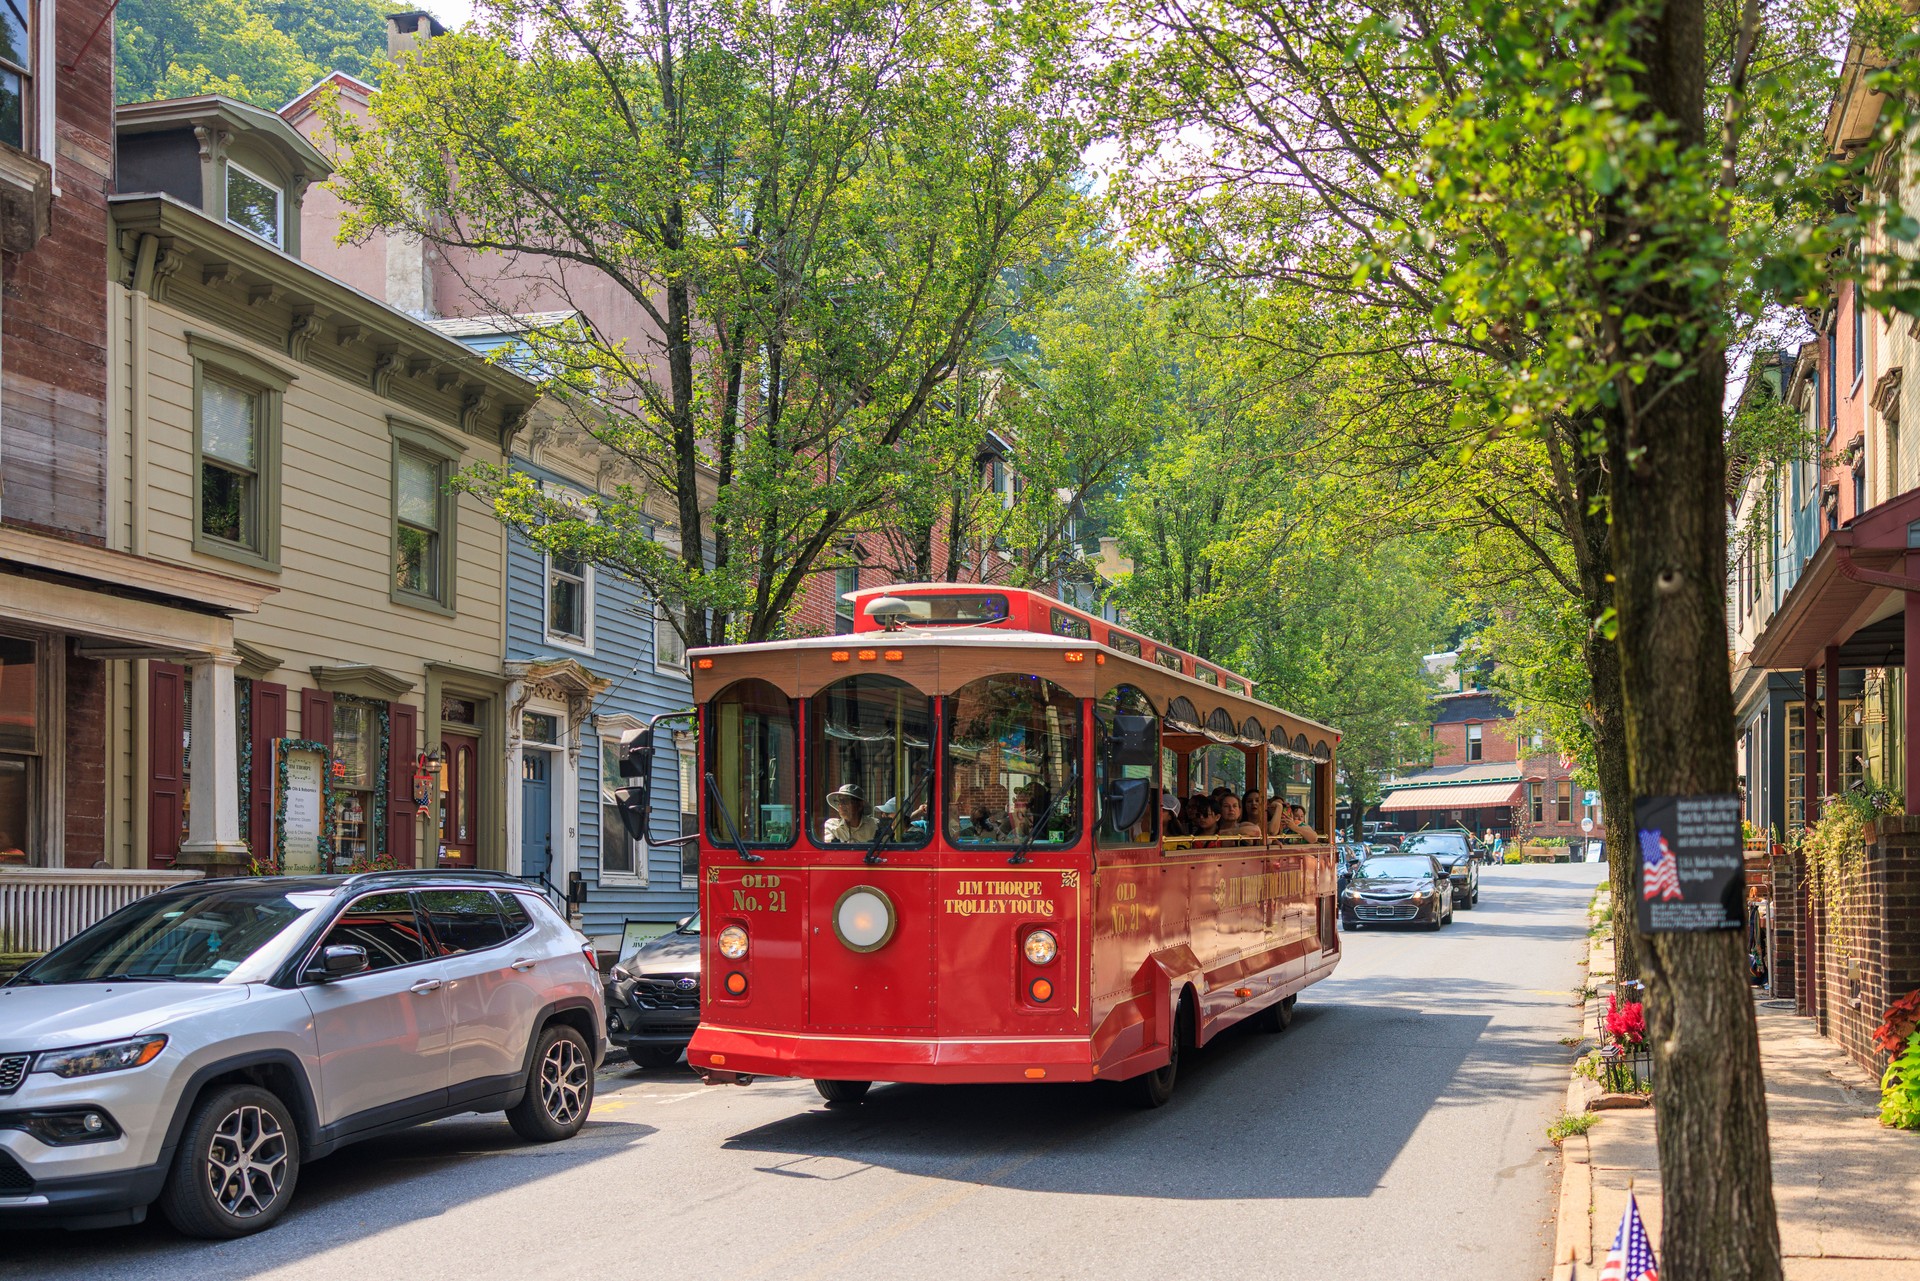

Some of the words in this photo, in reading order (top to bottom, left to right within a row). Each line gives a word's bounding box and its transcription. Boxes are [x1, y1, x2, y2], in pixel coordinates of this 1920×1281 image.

[569, 827, 575, 838] 93
[742, 874, 780, 888] OLD
[957, 881, 983, 896] JIM
[985, 881, 1042, 898] THORPE
[1116, 882, 1136, 902] OLD
[732, 890, 763, 912] No.
[769, 891, 787, 912] 21
[944, 900, 1009, 917] TROLLEY
[1009, 900, 1054, 916] TOURS
[1111, 906, 1128, 935] No.
[1130, 908, 1139, 931] 21
